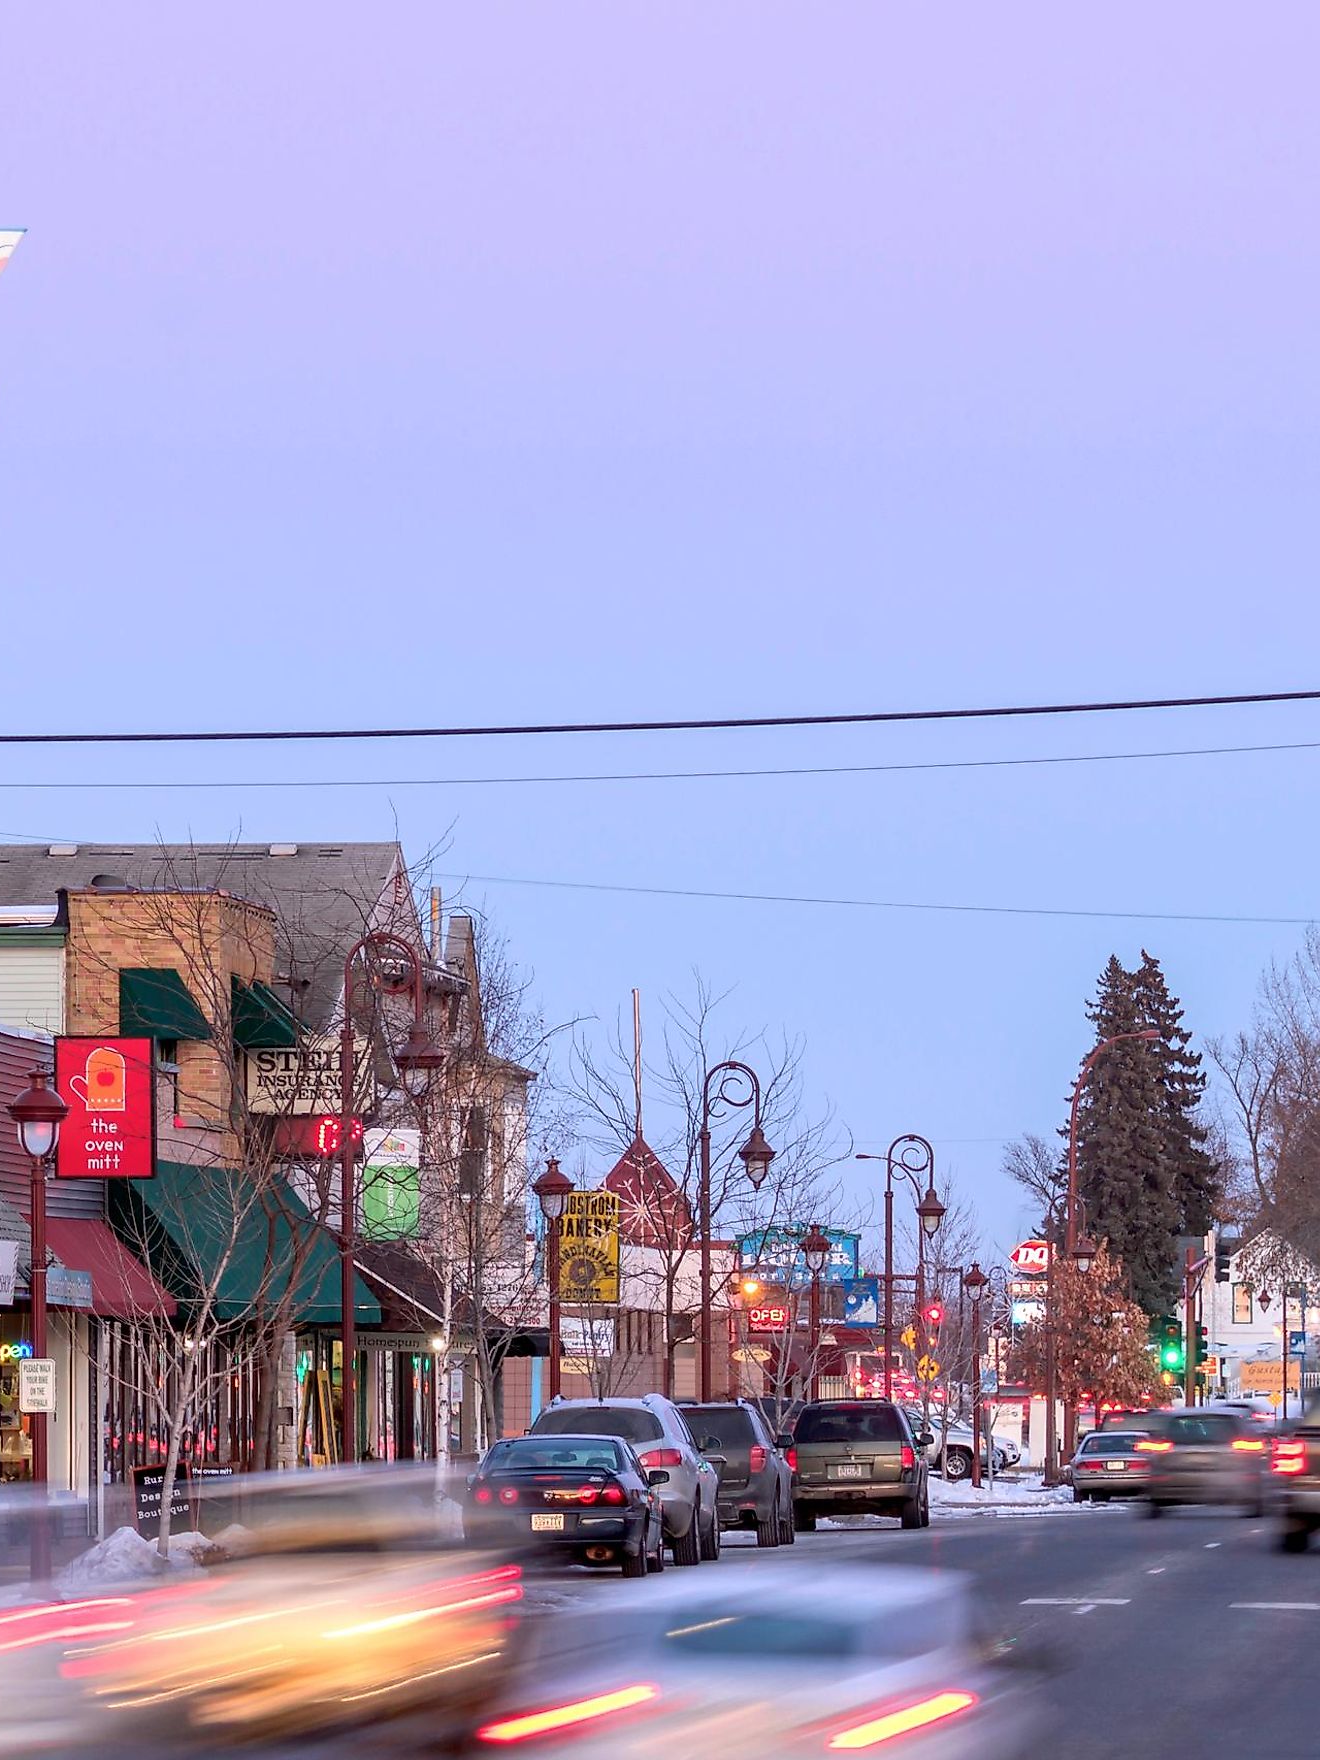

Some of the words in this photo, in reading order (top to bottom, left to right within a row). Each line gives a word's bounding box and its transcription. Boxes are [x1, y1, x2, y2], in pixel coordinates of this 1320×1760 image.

[257, 1075, 361, 1087] INSURANE
[91, 1118, 118, 1134] the
[87, 1153, 121, 1170] mitt
[1017, 1247, 1048, 1265] DQ
[357, 1336, 420, 1349] Homespun
[137, 1503, 189, 1520] Boutque
